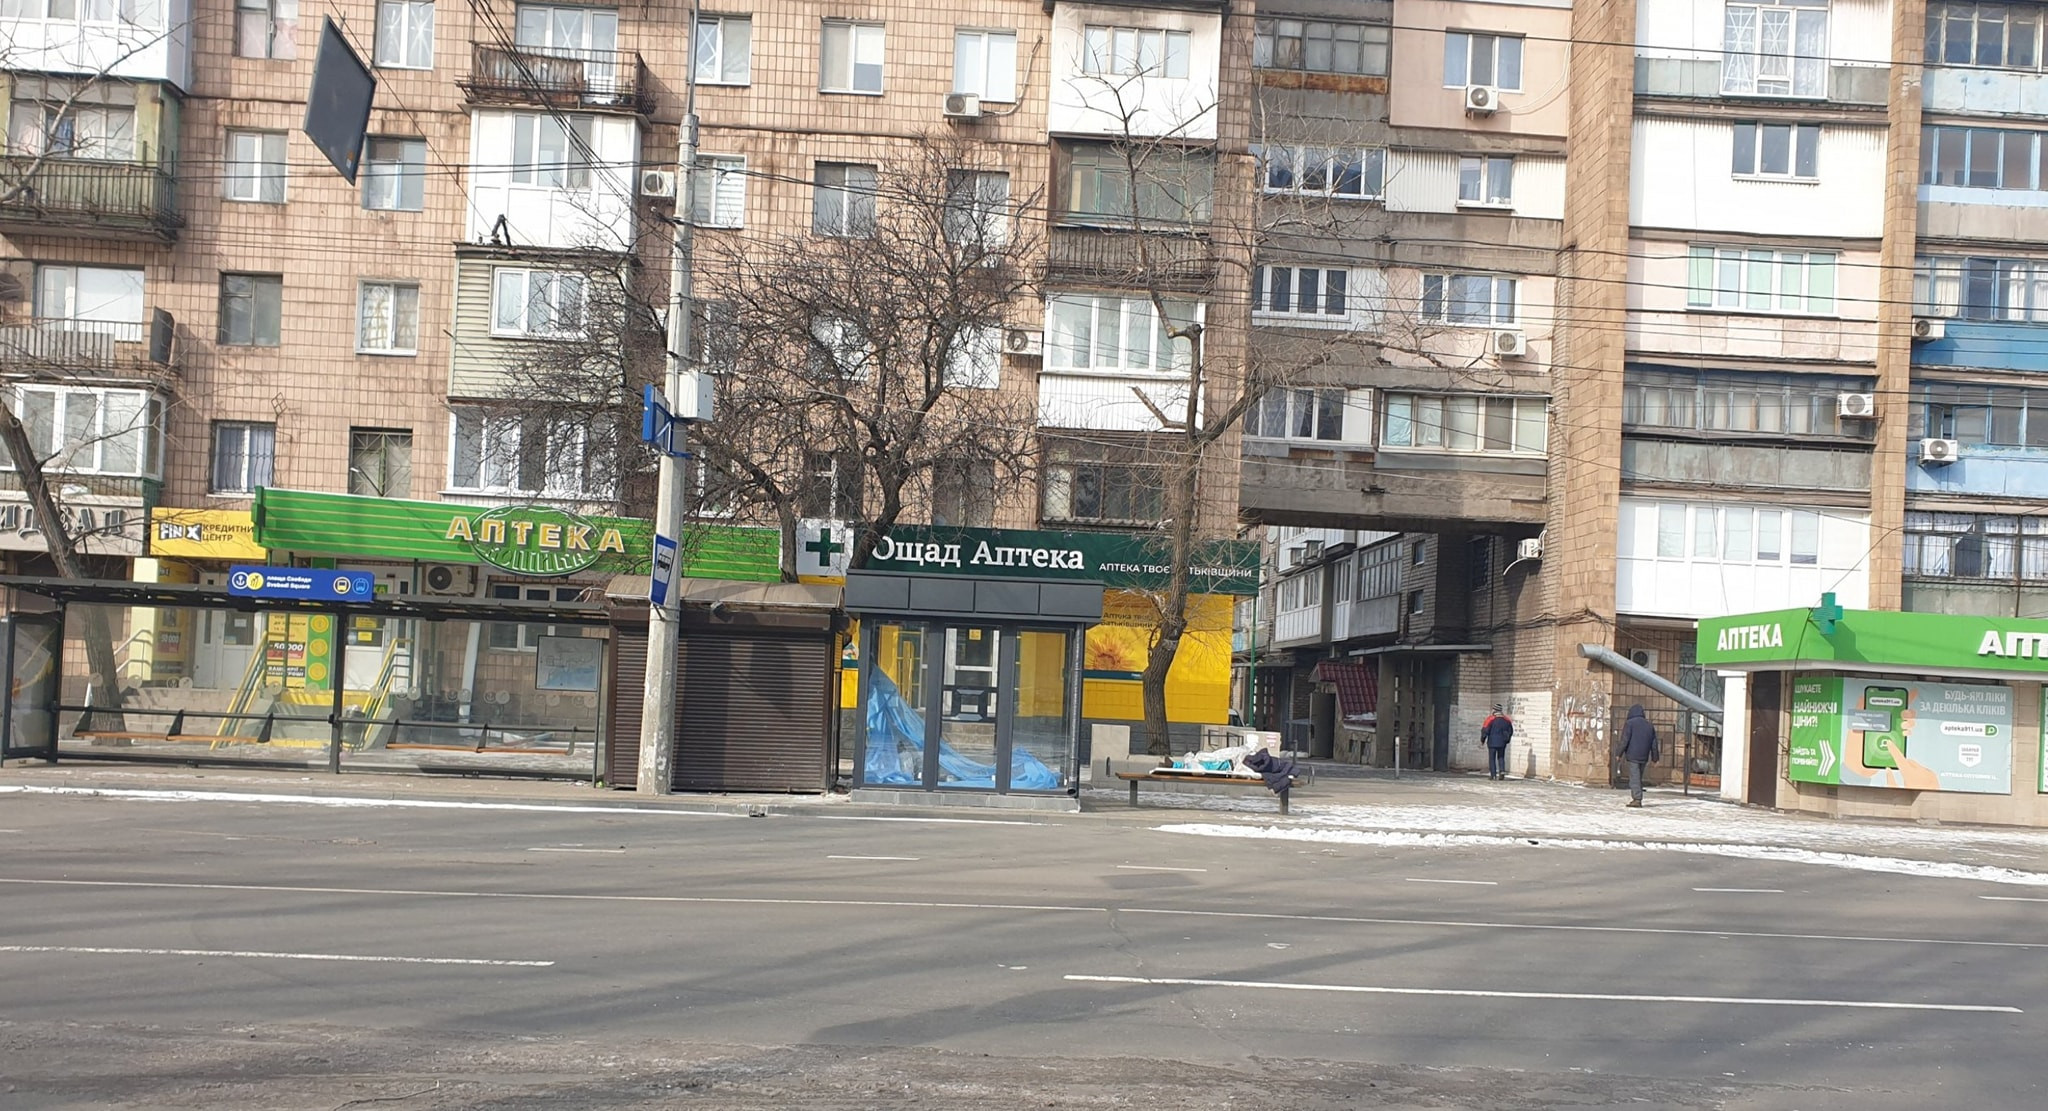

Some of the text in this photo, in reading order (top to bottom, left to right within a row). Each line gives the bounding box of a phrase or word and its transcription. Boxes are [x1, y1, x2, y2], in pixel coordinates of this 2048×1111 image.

[202, 533, 233, 542] ЦЕНТР
[446, 516, 625, 553] АПТЕКА
[970, 540, 1084, 570] Аптека
[1099, 563, 1252, 578] АПТЕКА ТВОЄ ТЬКІВЩИНИ
[1717, 623, 1783, 651] АПТЕКА
[1944, 690, 2006, 702] БУДЬ-ЯКІ ЛІКИ
[1793, 699, 1837, 714] НАЙНИЖЧІ
[1920, 701, 2006, 716] ЗА ДЕКІЛЬКА КЛІКІВ
[1944, 726, 1983, 734] apteka911.ua
